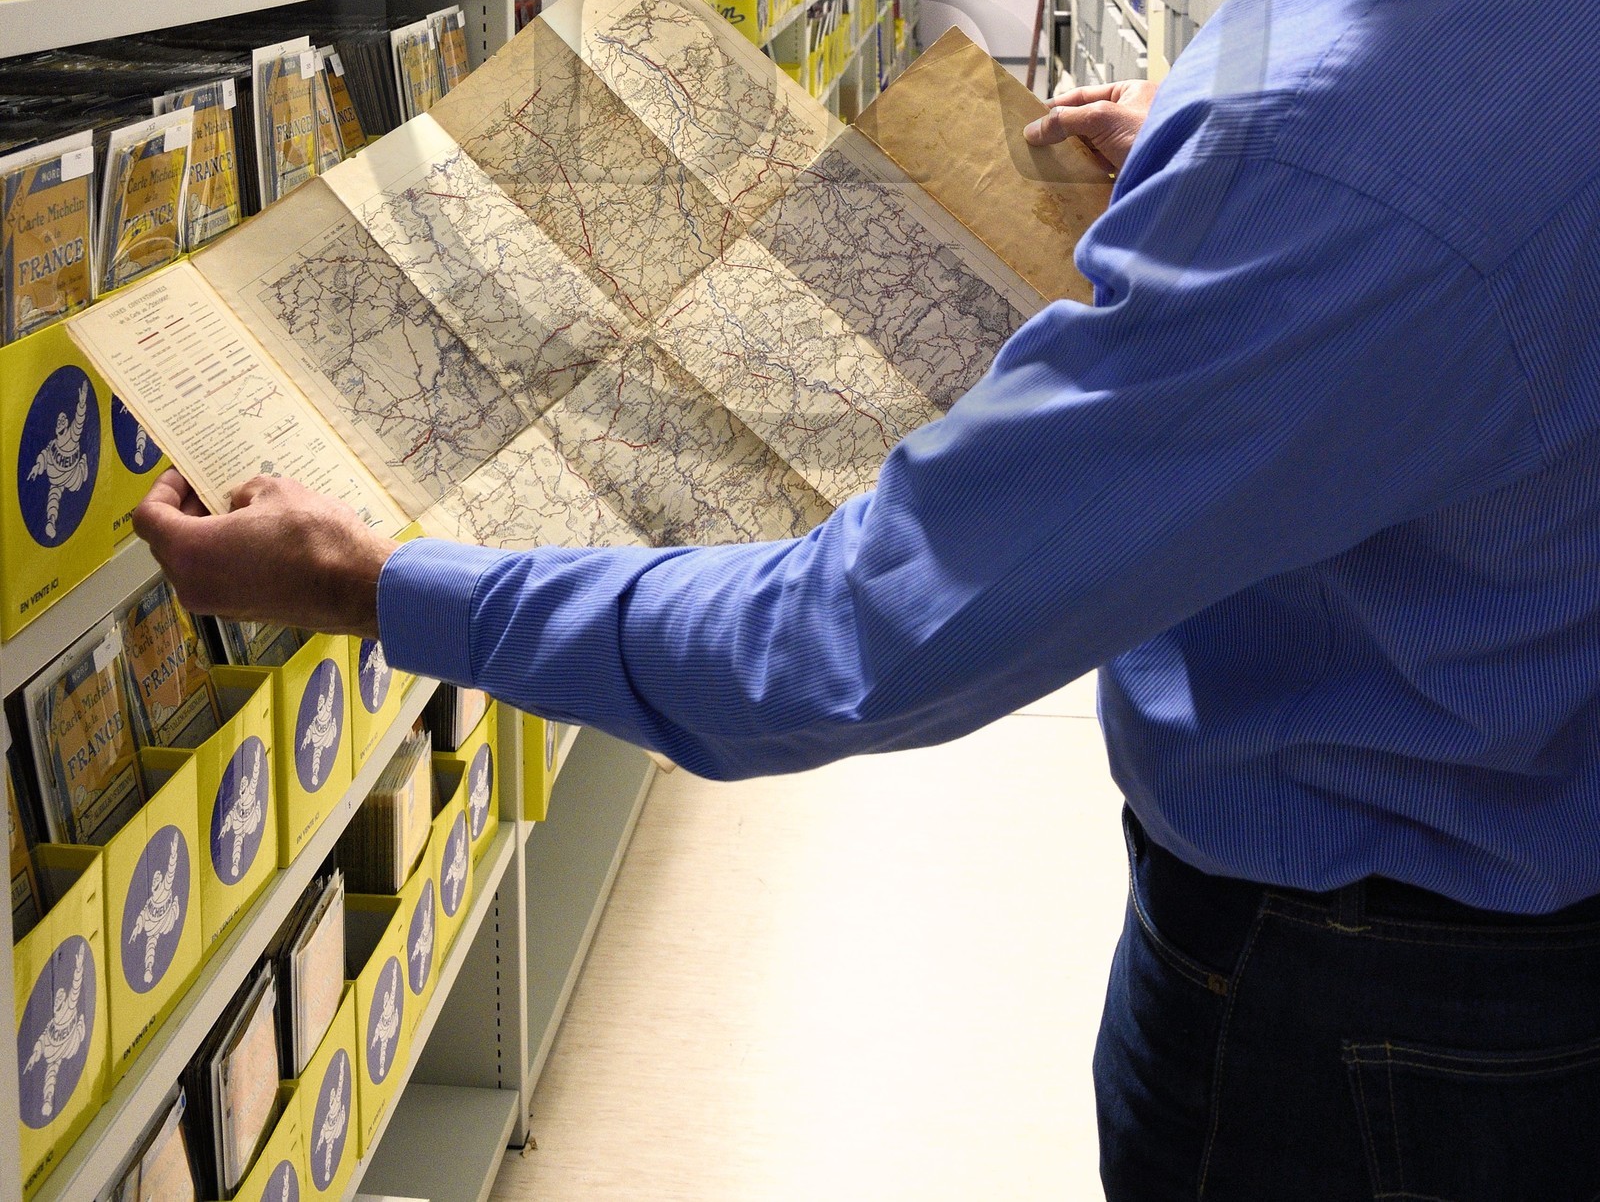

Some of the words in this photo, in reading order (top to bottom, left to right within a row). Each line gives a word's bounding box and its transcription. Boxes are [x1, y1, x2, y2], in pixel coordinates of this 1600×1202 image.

[276, 116, 312, 143] FRANCE
[126, 176, 146, 194] Carte
[189, 151, 234, 185] FRANCE
[18, 212, 45, 234] Carte
[47, 197, 84, 221] Michelin
[18, 237, 84, 286] FRANCE
[50, 445, 80, 468] MICHELIN
[112, 520, 121, 531] EN
[20, 604, 29, 614] EN
[30, 588, 50, 605] VENTE
[51, 578, 59, 589] ICI
[133, 635, 154, 659] Carte
[142, 637, 196, 698] FRANCE
[61, 711, 83, 737] Carte
[67, 710, 125, 780] FRANCE
[123, 1045, 131, 1060] EN
[132, 1026, 148, 1048] VENTE
